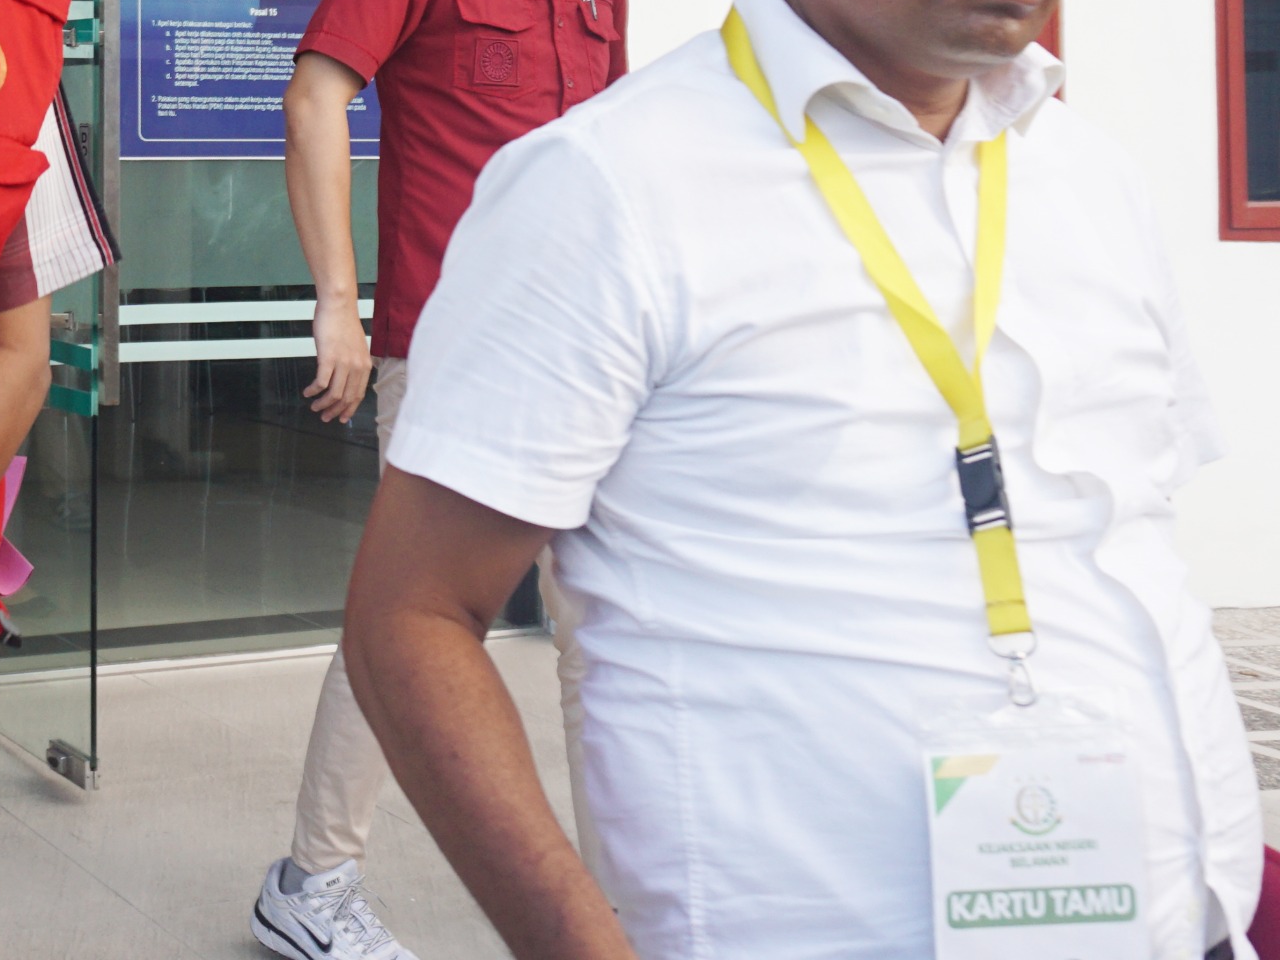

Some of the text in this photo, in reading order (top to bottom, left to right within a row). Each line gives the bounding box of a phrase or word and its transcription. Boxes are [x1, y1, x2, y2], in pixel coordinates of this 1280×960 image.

[250, 8, 267, 16] Pasal
[950, 886, 1132, 922] KARTU TAMU
